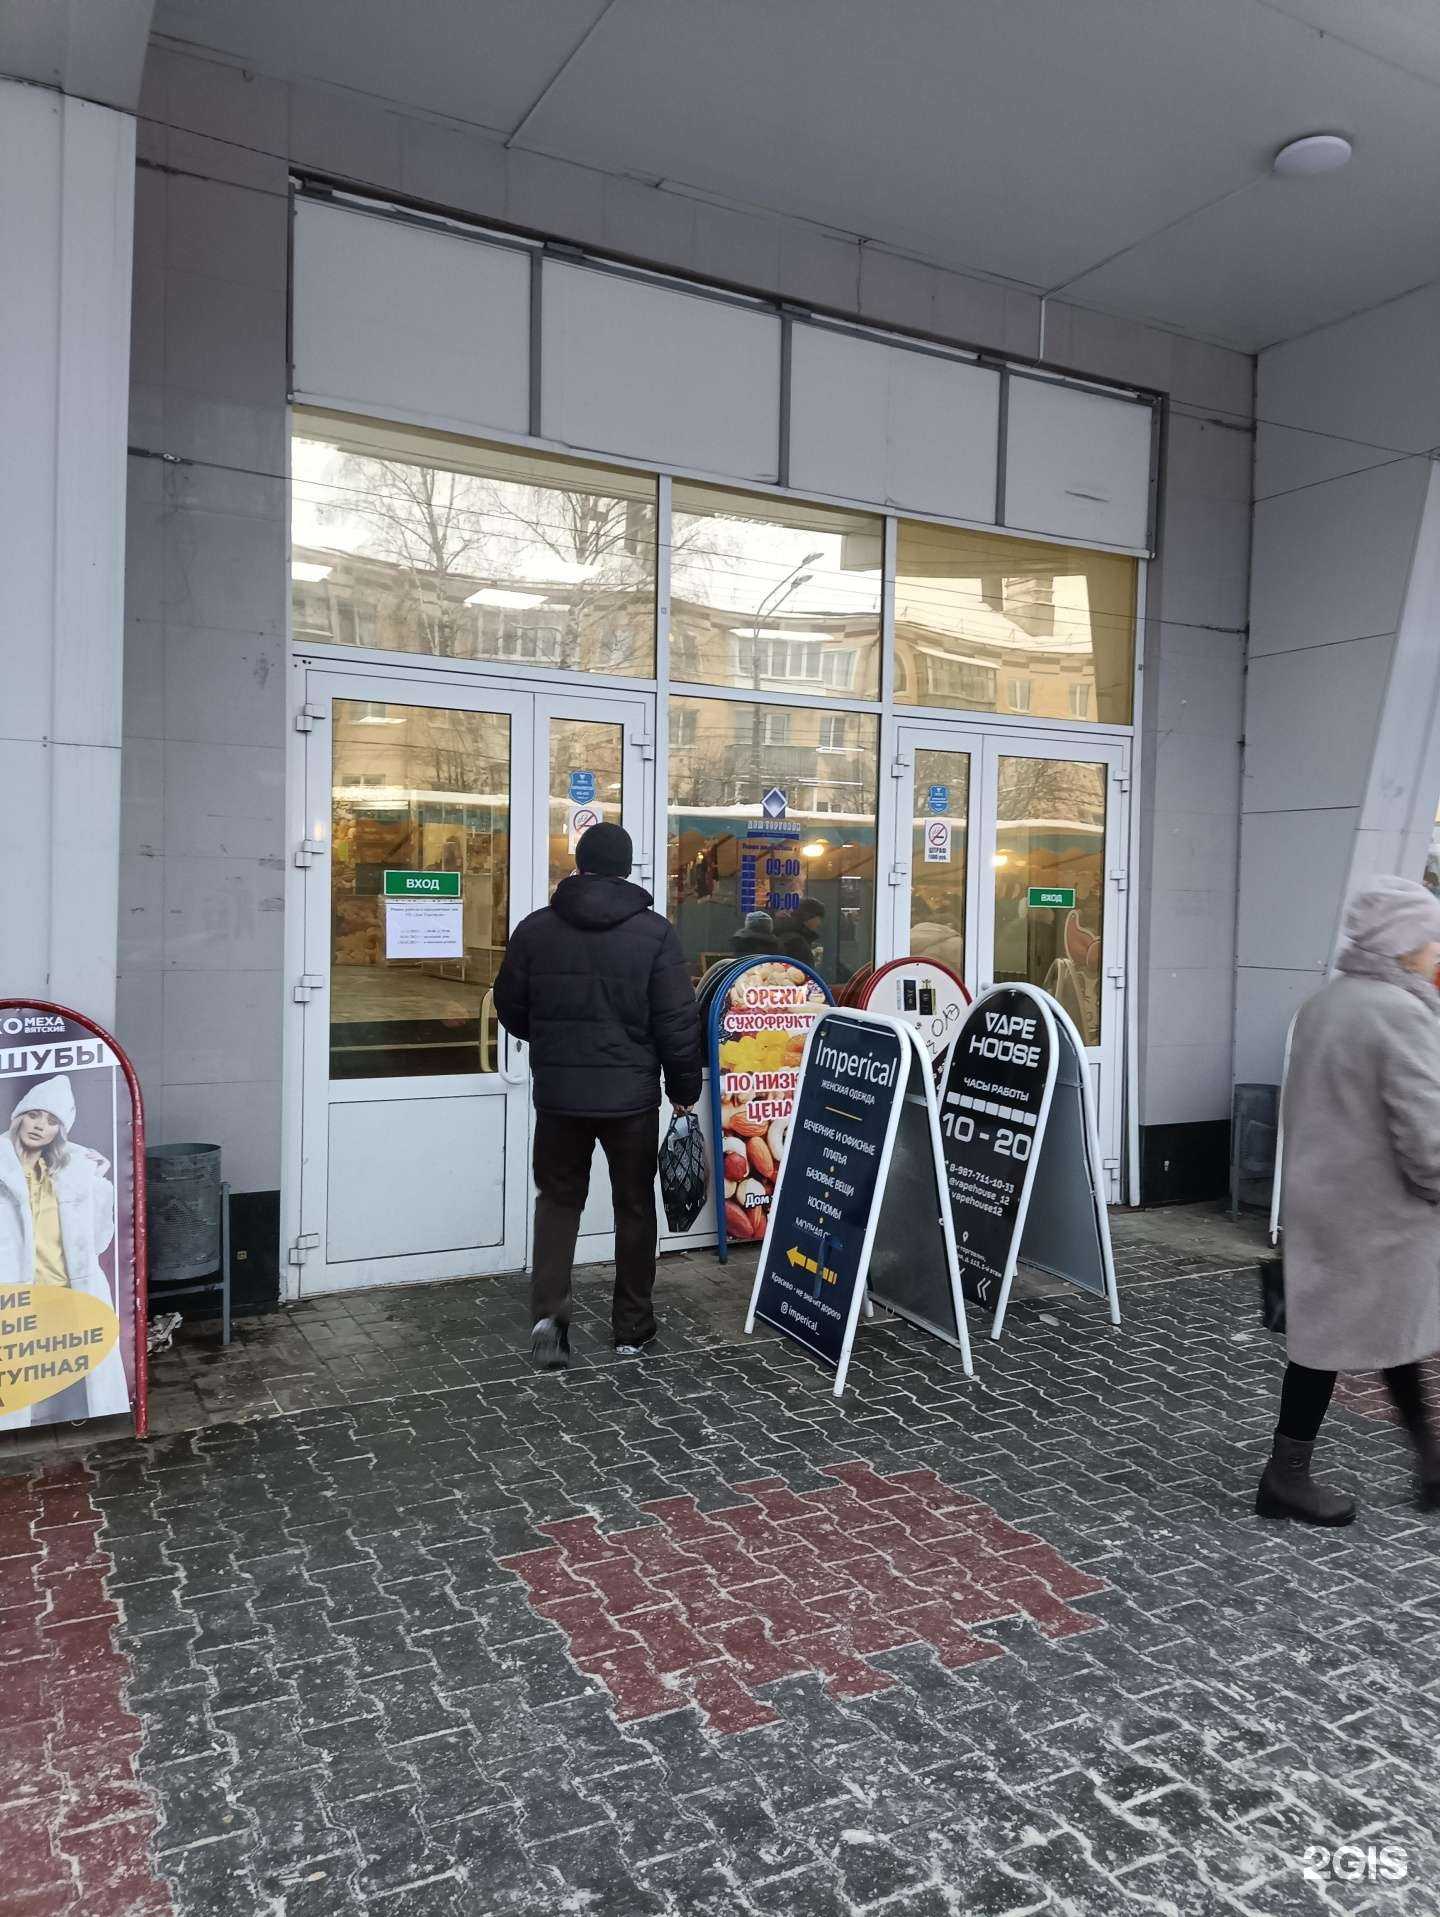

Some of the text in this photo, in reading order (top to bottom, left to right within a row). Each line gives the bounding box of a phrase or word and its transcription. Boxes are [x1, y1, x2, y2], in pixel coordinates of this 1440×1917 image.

[766, 858, 800, 876] 09:00
[406, 878, 440, 891] ВХОД
[1040, 893, 1063, 904] ВХОД
[745, 987, 805, 1006] ОРЕХИ
[24, 1016, 65, 1026] МЕХА
[24, 1025, 66, 1034] ВЯТСКИЕ
[726, 1013, 817, 1030] СУХОФРУКТ
[985, 1011, 1037, 1040] VAPE
[0, 1043, 104, 1073] ШУБЫ
[815, 1039, 898, 1088] Imperical
[969, 1034, 1041, 1068] HOUSE
[726, 1075, 750, 1092] ПО
[821, 1079, 876, 1105] ЖЕНСКАЯ ОДЕЖДА
[963, 1076, 990, 1092] ЧАСЫ
[991, 1084, 1030, 1102] РАБОТЫ
[803, 1119, 876, 1156] ВЕЧЕРНИЕ И ОФИСНЫЕ
[942, 1112, 975, 1143] 10
[993, 1127, 1033, 1162] 20
[822, 1147, 848, 1165] ПЛАТЬЯ
[805, 1166, 855, 1197] БАЗОВЫЕ ВЕЩИ
[948, 1177, 1010, 1206] @vapehouse_12
[745, 1193, 769, 1207] Дом
[806, 1195, 842, 1220] КОСТЮМЫ
[951, 1191, 1004, 1217] vapehouse12
[0, 1327, 104, 1362] ТИЧНЫЕ
